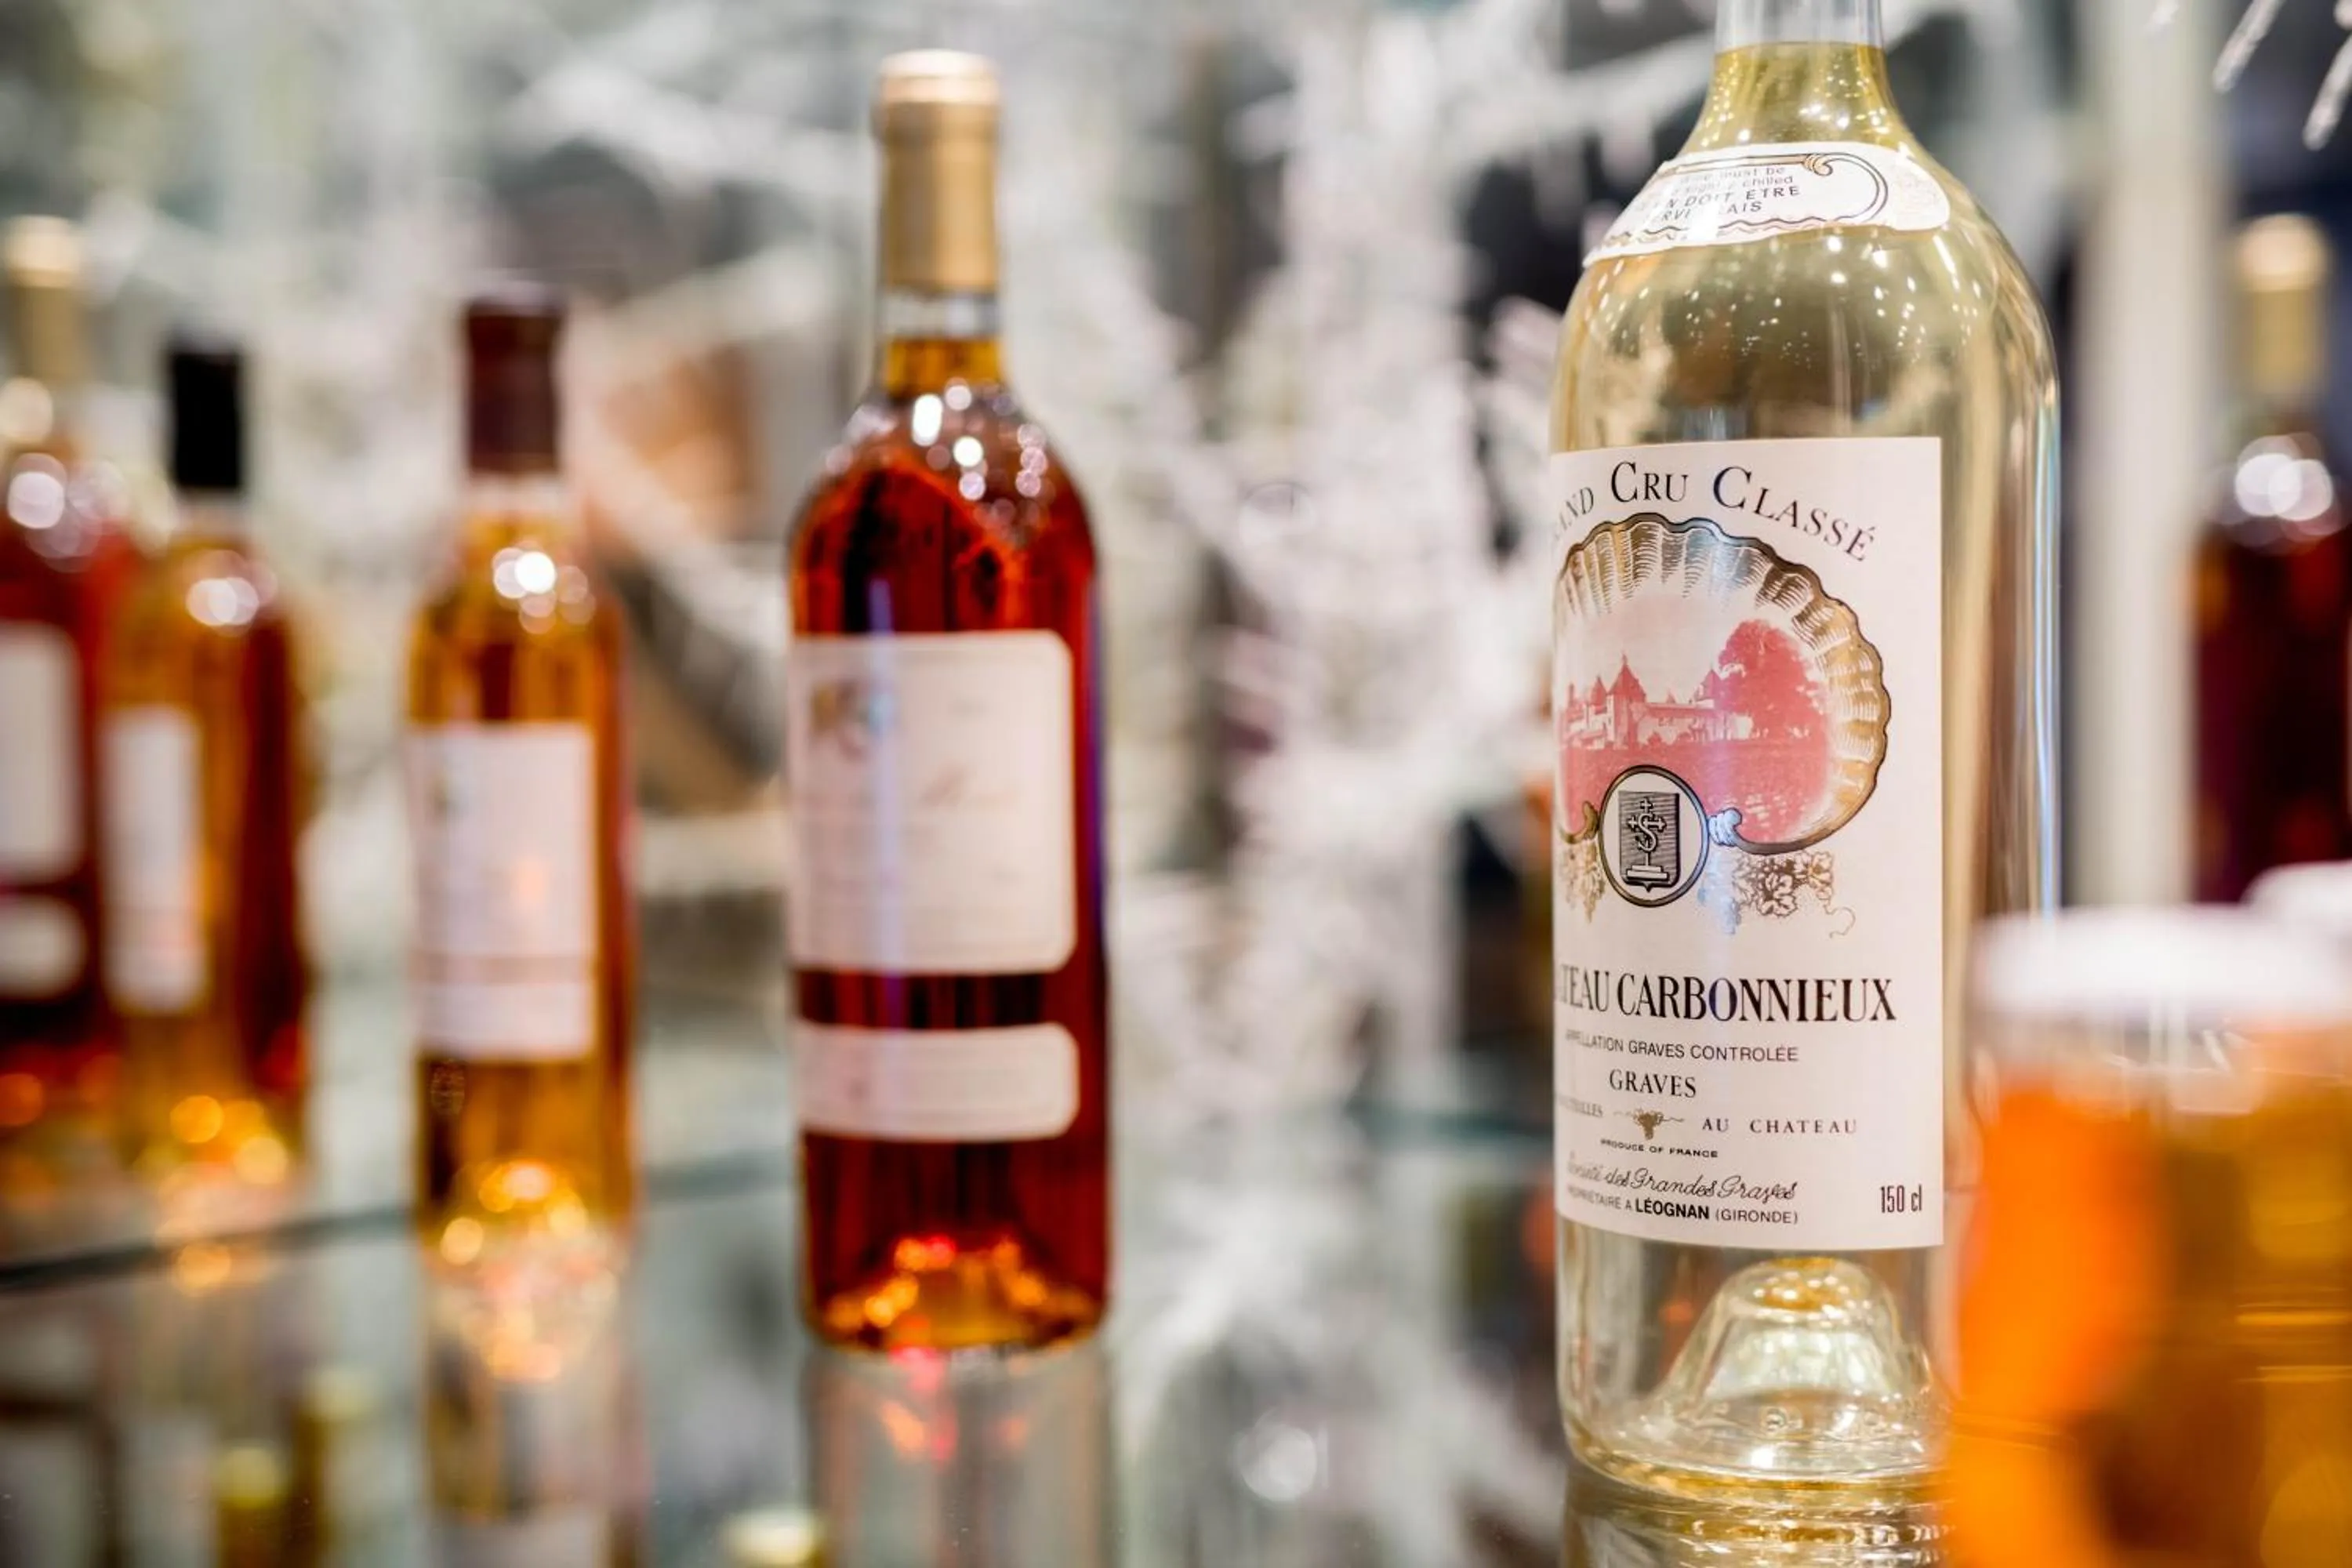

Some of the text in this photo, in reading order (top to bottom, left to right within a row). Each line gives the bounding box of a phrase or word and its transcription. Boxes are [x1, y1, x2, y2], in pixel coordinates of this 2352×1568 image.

[1742, 174, 1794, 188] chilled
[1766, 166, 1785, 176] be
[1684, 191, 1735, 207] DOIT
[1745, 185, 1800, 201] ETRE
[1713, 465, 1877, 562] CLASSÉ
[1558, 964, 1896, 1022] TEAU CARBONNIEUX
[1628, 1039, 1686, 1059] GRAVES
[1690, 1044, 1799, 1062] CONTROLÉE
[1609, 1069, 1697, 1098] GRAVES
[1702, 1117, 1730, 1133] AU
[1749, 1118, 1857, 1134] CHATEAU
[1600, 1138, 1719, 1159] PRODUCE OF FRANCE
[1630, 1167, 1717, 1199] Grandes
[1716, 1174, 1798, 1204] Graves
[1635, 1196, 1710, 1221] LÉOGNAN
[1715, 1207, 1798, 1225] (GIRONDE)
[1879, 1184, 1923, 1214] 150 cl
